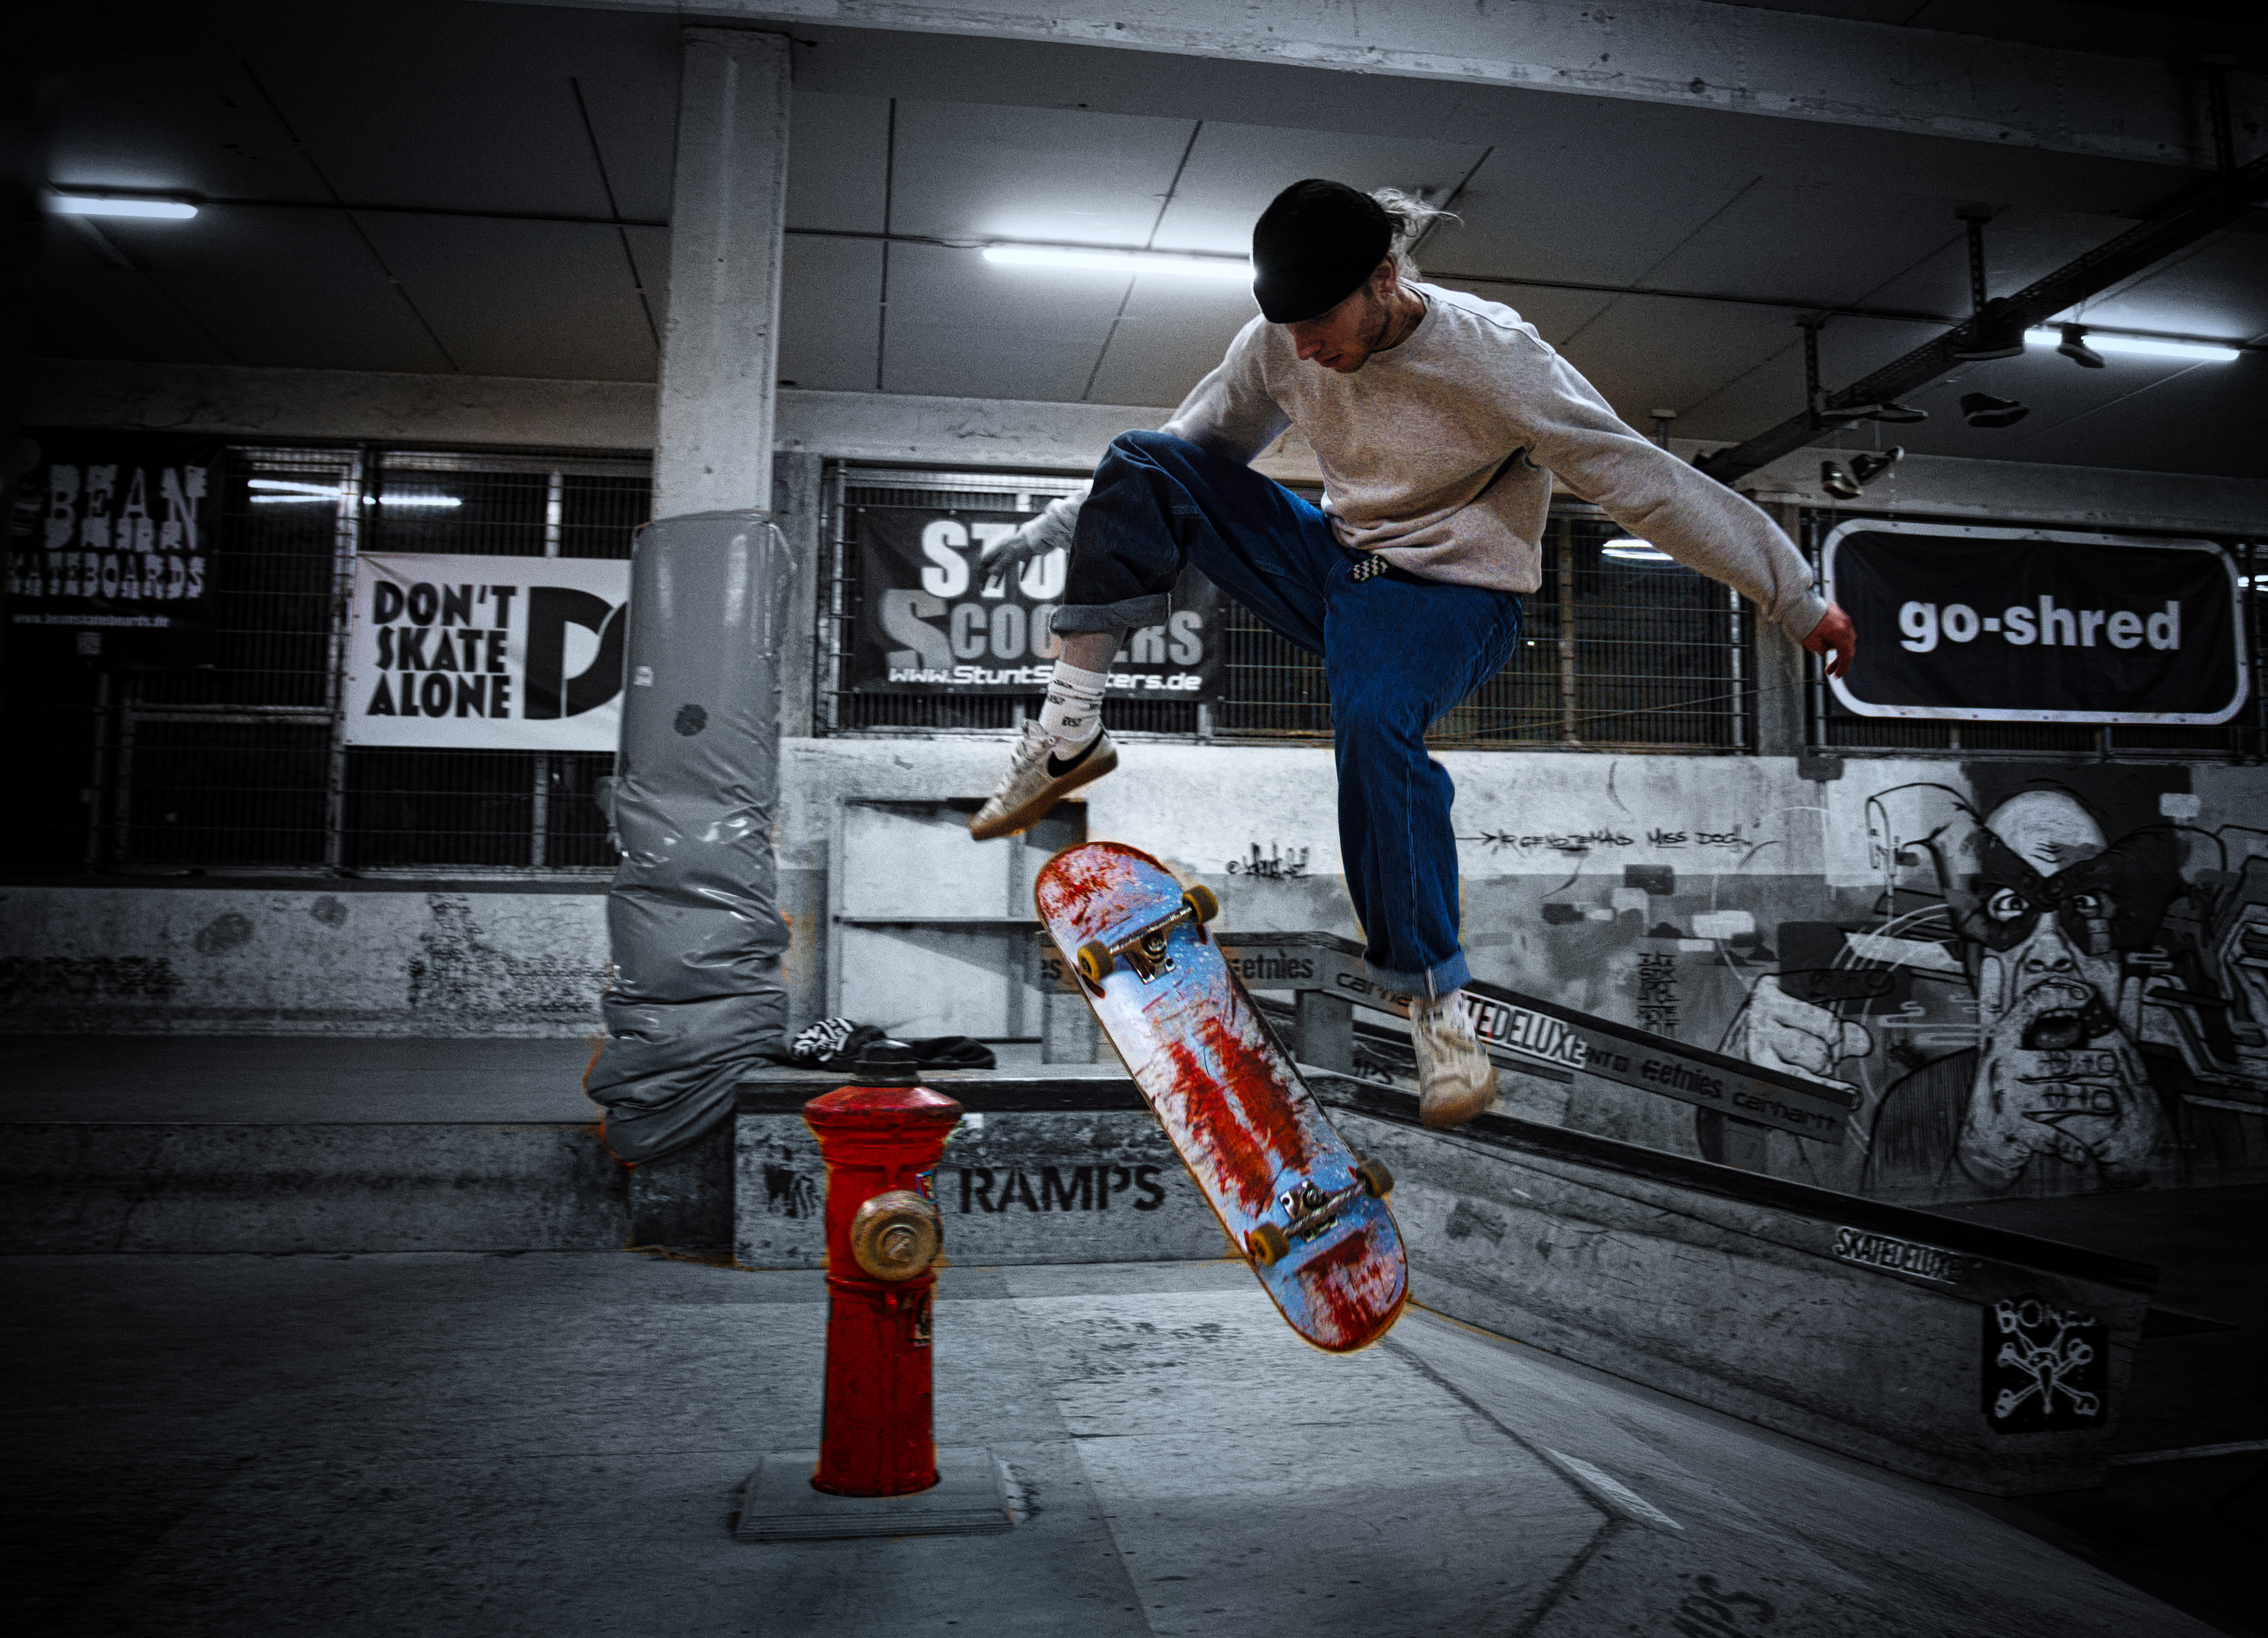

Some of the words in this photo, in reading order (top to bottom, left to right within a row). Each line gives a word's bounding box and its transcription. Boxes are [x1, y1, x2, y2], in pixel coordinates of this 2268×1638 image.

[45, 464, 208, 552] BEAN
[6, 550, 206, 600] KATEBOARDS
[922, 520, 1067, 599] STU
[372, 580, 518, 629] DON'T
[882, 589, 1204, 669] SCOORS
[1898, 594, 2181, 653] go-shred
[375, 625, 509, 674] SKATE
[366, 672, 511, 719] ALONE
[890, 664, 1203, 691] www.StuntSters.de
[1242, 948, 1314, 980] etnies
[1462, 990, 1588, 1067] TEDELUXE
[1658, 1059, 1725, 1099] etnies
[1732, 1091, 1838, 1131] carhartt
[959, 1163, 1166, 1214] RAMPS
